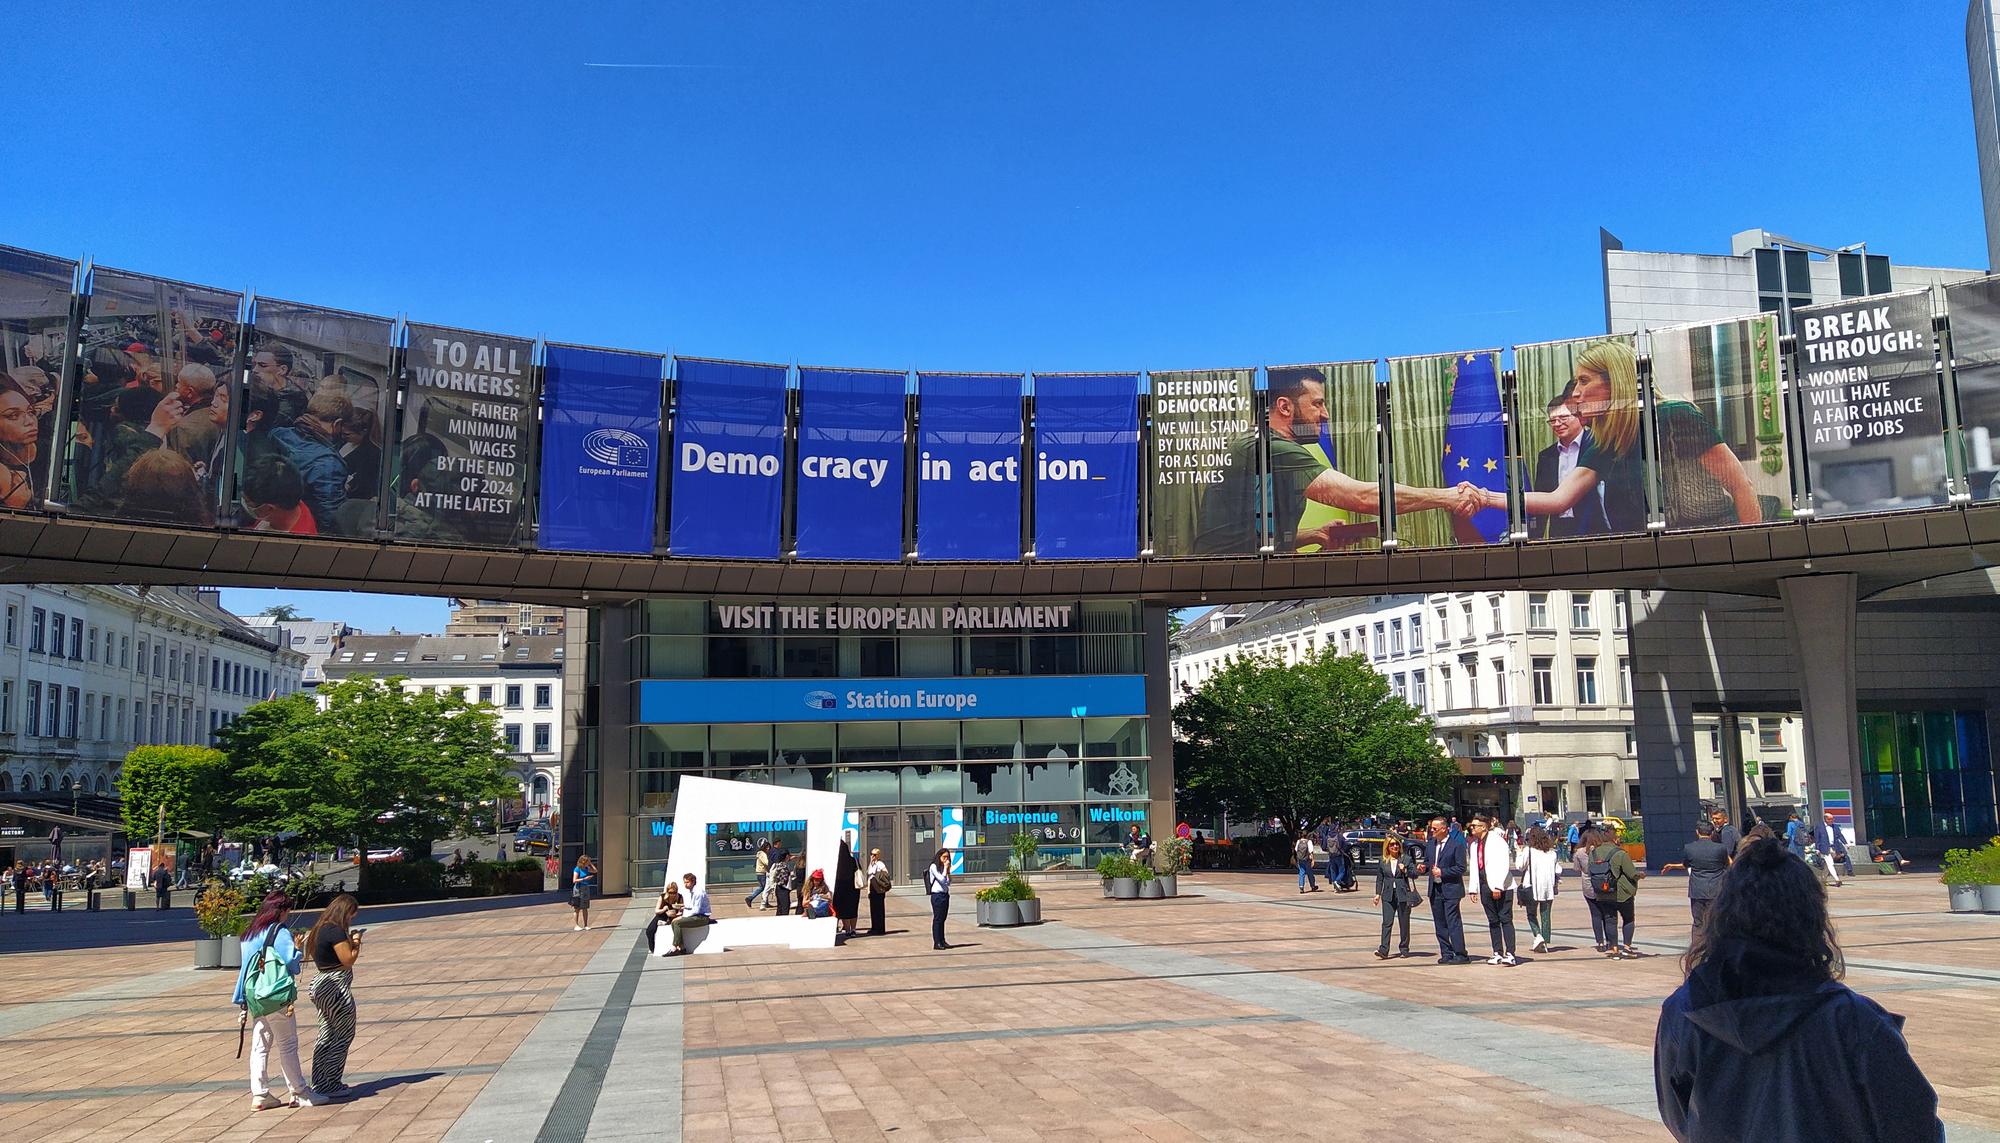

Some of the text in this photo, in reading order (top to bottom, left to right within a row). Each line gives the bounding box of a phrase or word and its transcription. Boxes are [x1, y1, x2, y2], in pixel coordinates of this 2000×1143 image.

[1804, 306, 1892, 341] BREAK
[432, 338, 521, 375] TO ALL
[1805, 329, 1923, 363] THROUGH:
[415, 366, 521, 398] WORKERS:
[1157, 379, 1238, 396] DEFENDING
[1808, 365, 1869, 388] WOMEN
[1810, 381, 1892, 406] WILL HAVE
[471, 402, 518, 421] FAIRER
[1158, 396, 1250, 414] DEMOCRACY:
[1812, 397, 1924, 425] A FAIR CHANCE
[448, 418, 517, 440] MINIMUM
[1157, 419, 1249, 435] WE WILL STAND
[1814, 418, 1904, 444] AT TOP JOBS
[469, 439, 516, 458] WAGES
[1158, 436, 1228, 452] BY UKRAINE
[437, 455, 515, 477] BY THE END
[681, 442, 780, 477] Demo
[802, 456, 889, 488] cracy
[921, 451, 951, 481] in
[968, 456, 1018, 482] act
[1158, 453, 1232, 468] FOR AS LONG
[579, 466, 648, 478] European Parliament
[1158, 470, 1225, 485] AS IT TAKES
[460, 477, 514, 495] OF 2024
[415, 492, 513, 514] AT THE LATEST
[718, 605, 1072, 629] VISIT THE EUROPEAN PARLIAMENT
[846, 690, 977, 712] Station Europe
[985, 807, 1145, 825] Bienvenue Welkom
